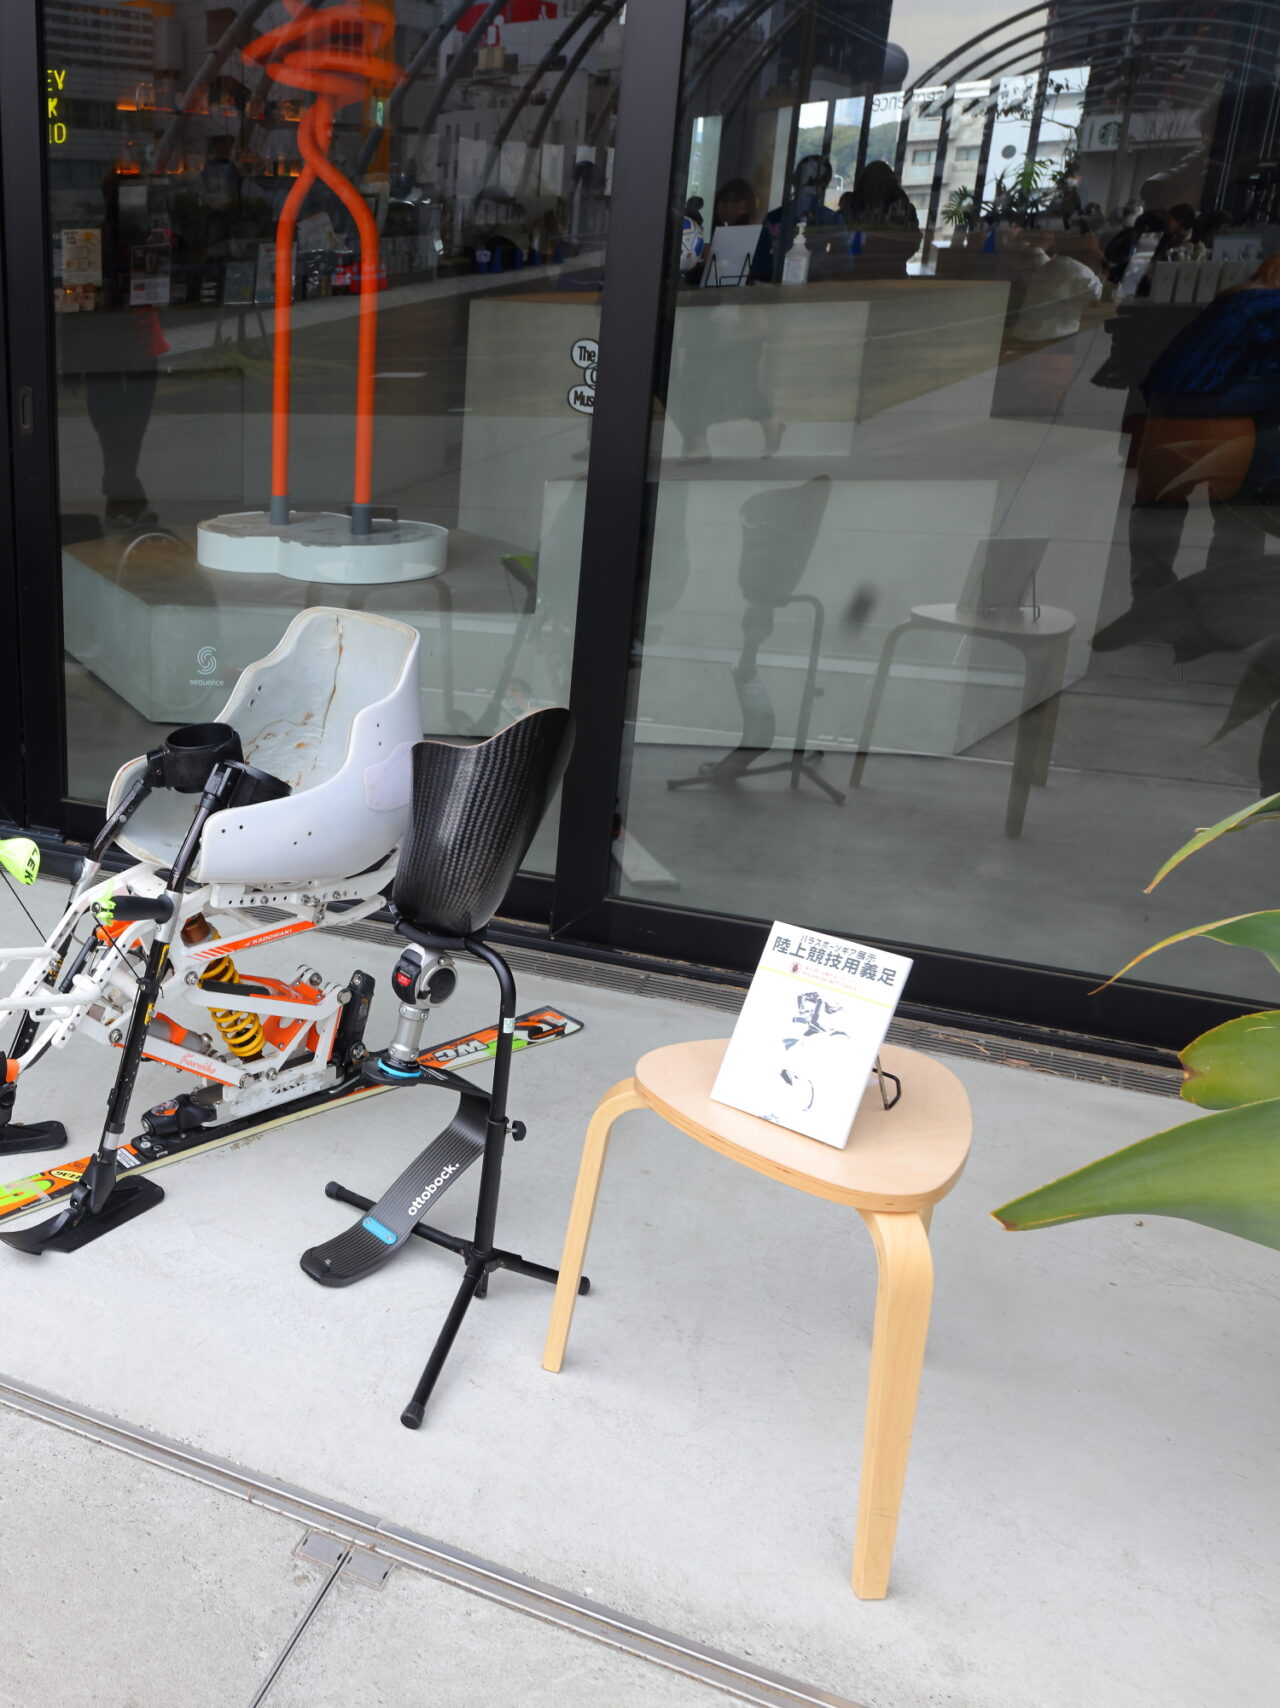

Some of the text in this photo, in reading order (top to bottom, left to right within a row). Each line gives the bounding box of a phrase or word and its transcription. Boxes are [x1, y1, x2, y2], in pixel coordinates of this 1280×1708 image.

[577, 345, 597, 362] The
[189, 679, 225, 688] sequence
[800, 934, 877, 963] パラスポーツギア展示
[772, 935, 897, 987] 陸上競技用義足
[432, 1038, 489, 1062] WC
